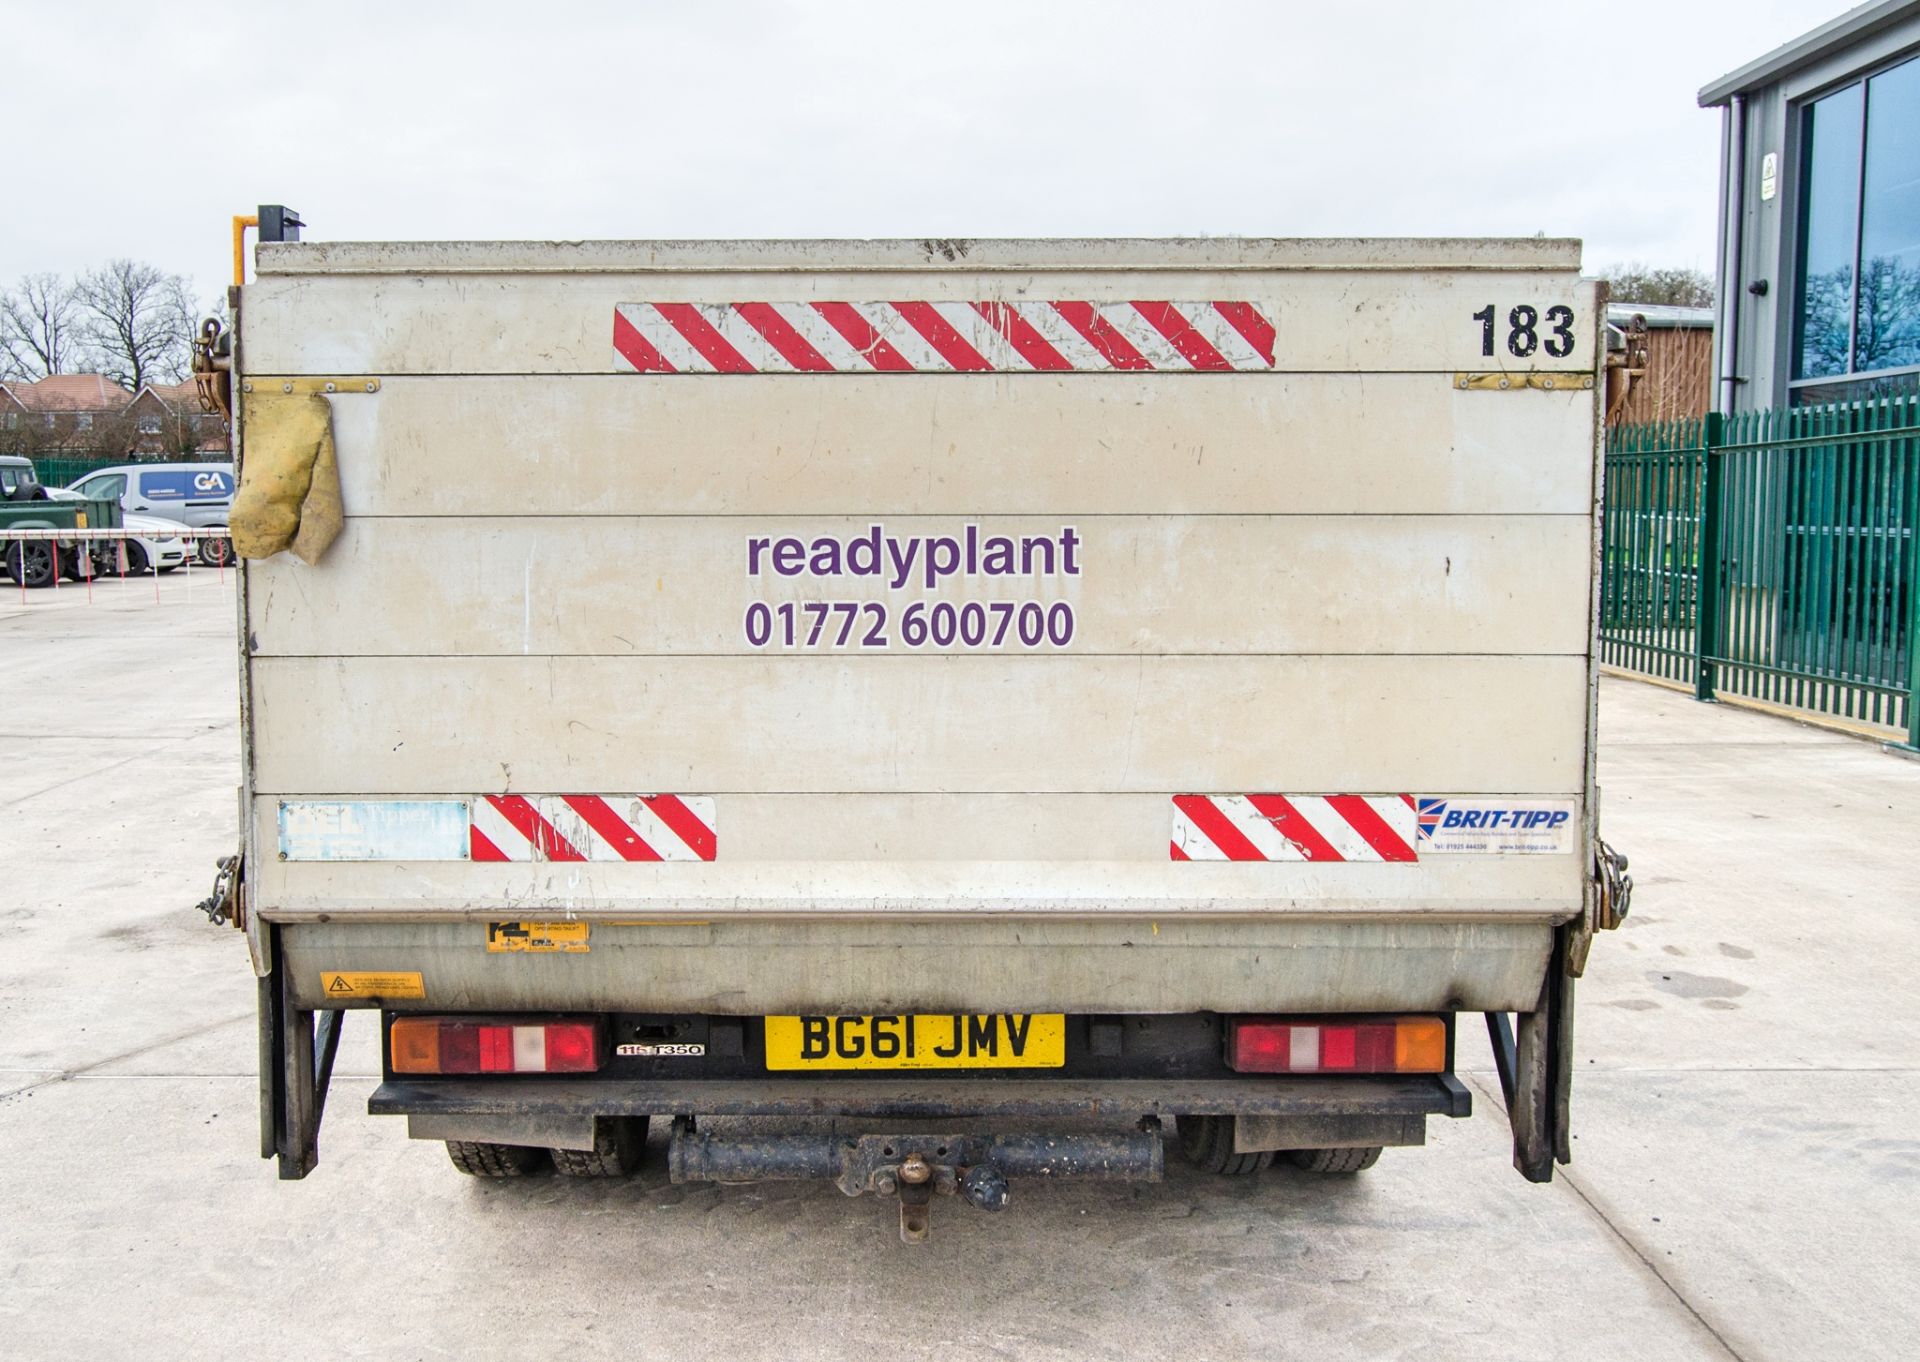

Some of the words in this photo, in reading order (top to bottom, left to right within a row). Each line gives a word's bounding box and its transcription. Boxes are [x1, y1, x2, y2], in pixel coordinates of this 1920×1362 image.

[1473, 304, 1575, 358] 183
[194, 472, 226, 490] GA
[747, 525, 1080, 589] readyplant
[745, 602, 887, 646] 01772
[901, 602, 1074, 646] 600700
[1442, 810, 1569, 829] BRIT-TIPP
[655, 1045, 702, 1055] T350
[800, 1015, 915, 1059] BG61
[933, 1014, 1032, 1058] JMV
